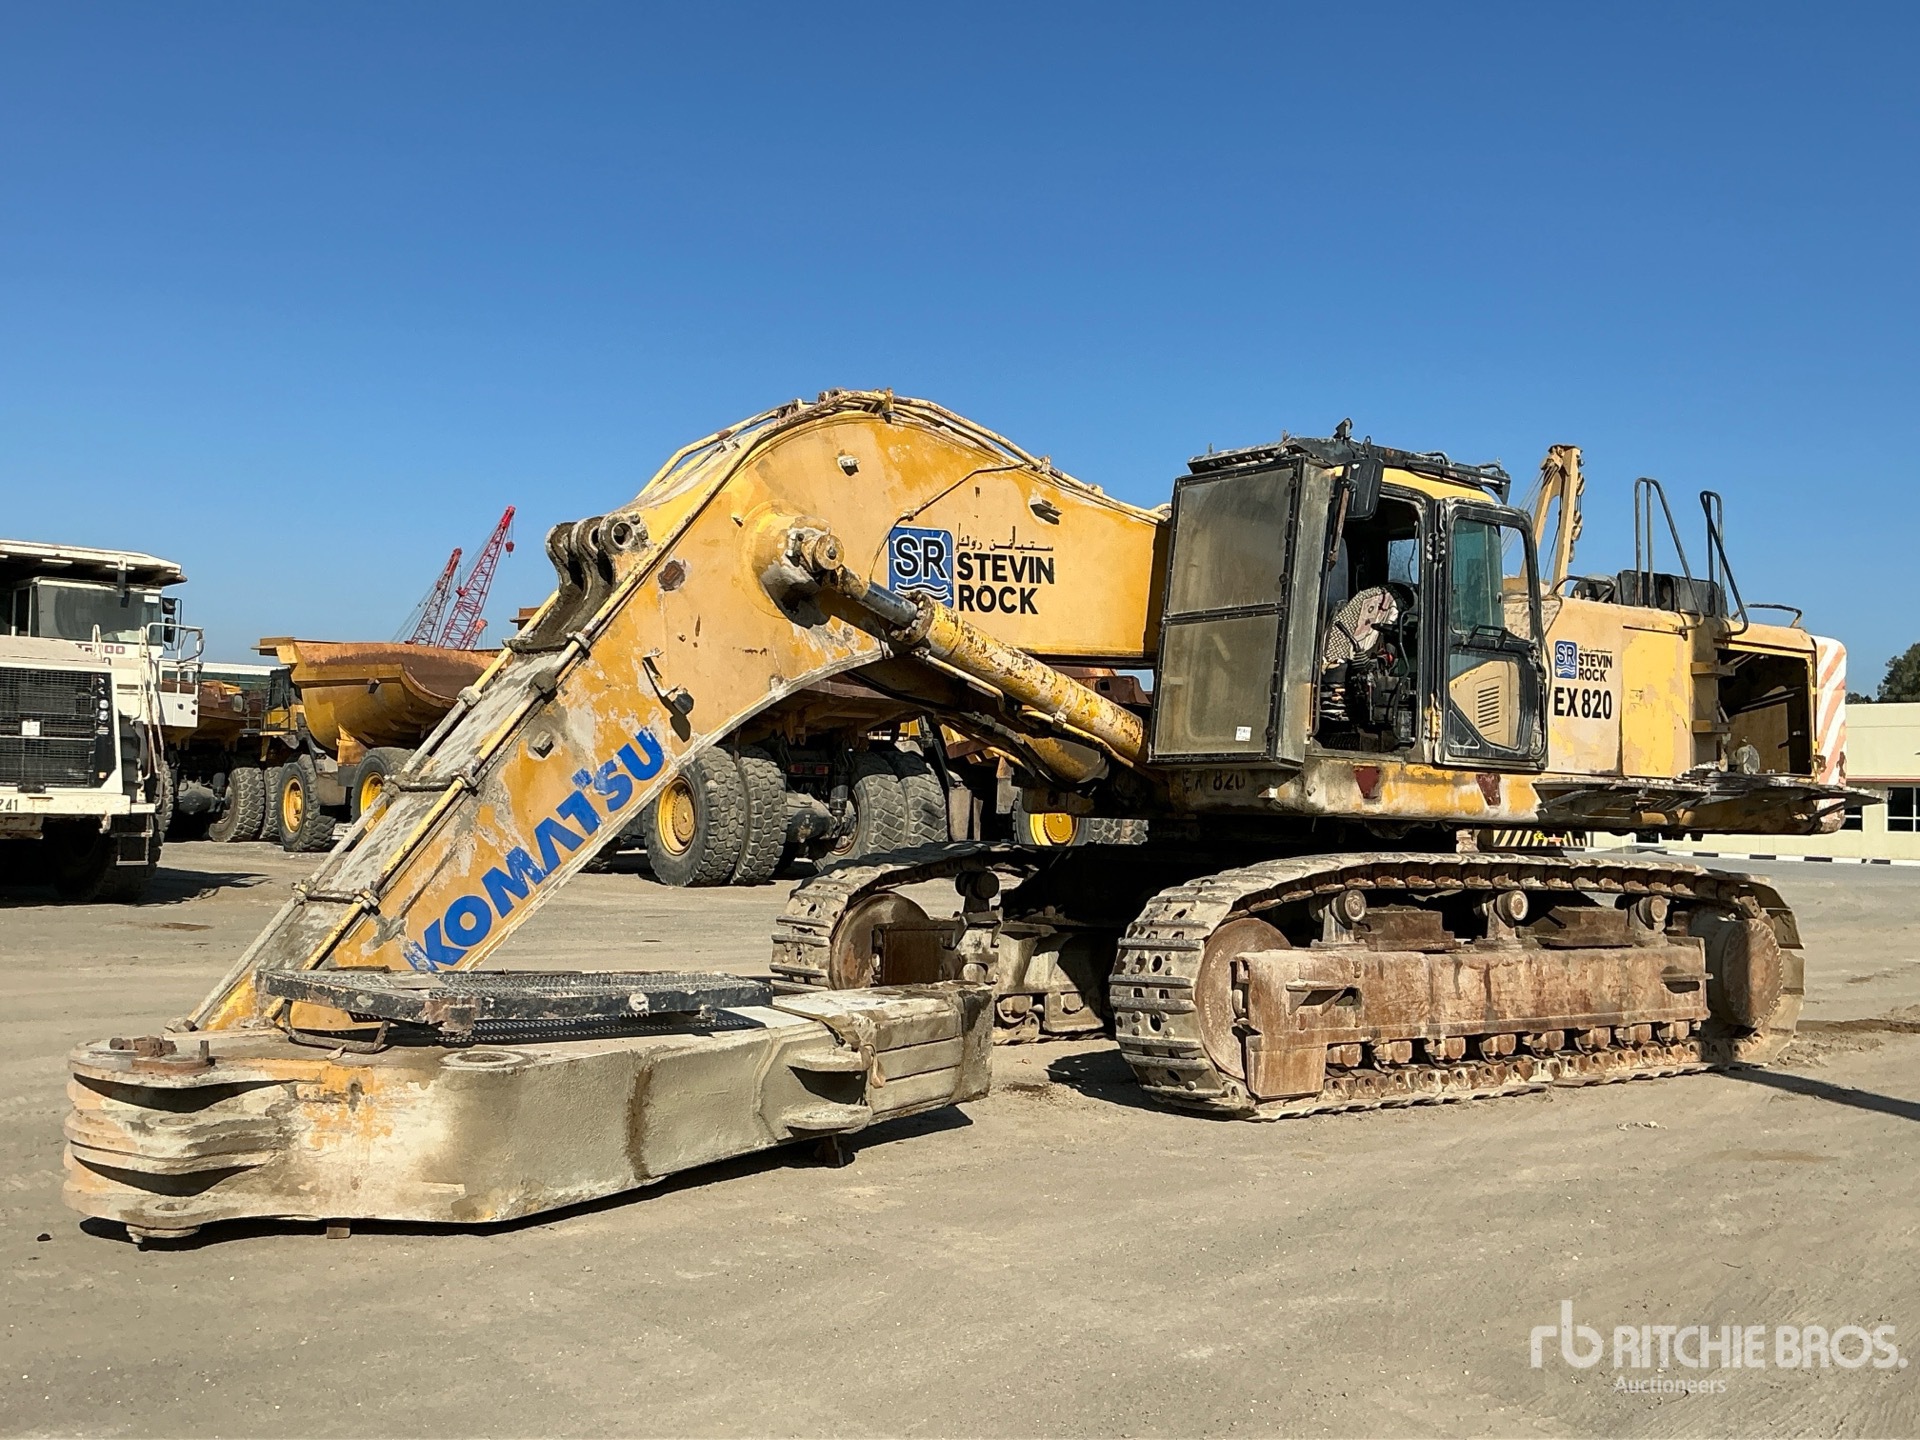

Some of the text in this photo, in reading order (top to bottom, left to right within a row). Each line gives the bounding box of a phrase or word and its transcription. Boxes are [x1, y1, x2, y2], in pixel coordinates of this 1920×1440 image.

[895, 535, 948, 580] SR
[957, 552, 1055, 584] STEVIN
[958, 584, 1039, 614] ROCK
[1556, 645, 1575, 664] SR
[1578, 653, 1612, 668] STEVIN
[1579, 668, 1607, 682] ROCK
[403, 727, 665, 971] KOMATSU
